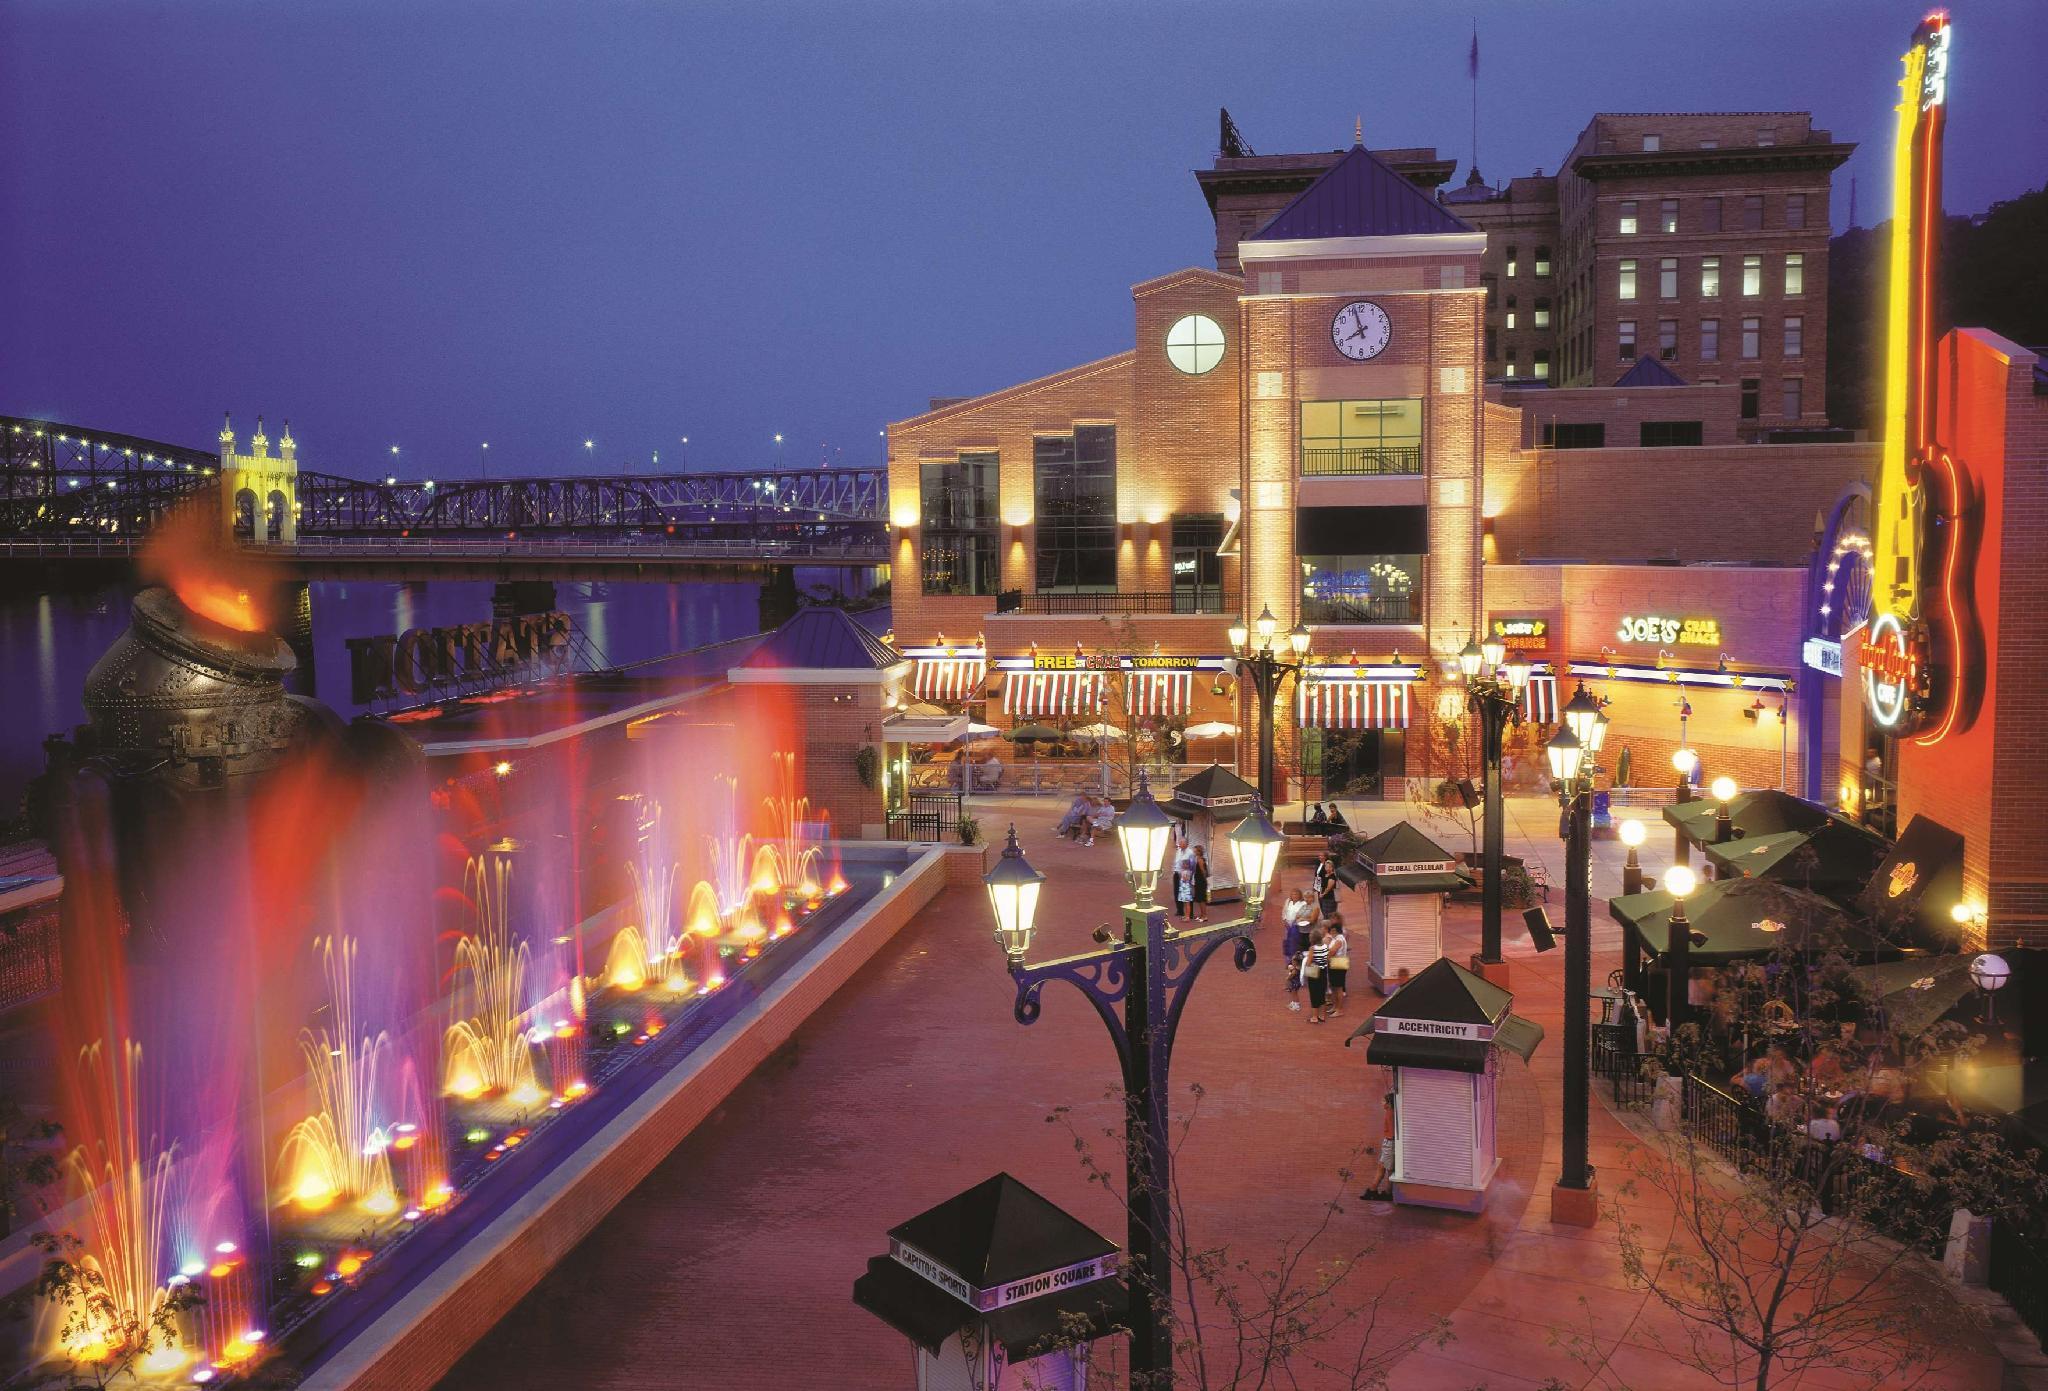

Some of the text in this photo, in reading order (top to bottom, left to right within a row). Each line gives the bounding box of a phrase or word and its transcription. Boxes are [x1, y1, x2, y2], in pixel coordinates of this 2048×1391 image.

[1617, 617, 1715, 643] JOE'S CRAB
[1680, 631, 1719, 645] SHACK
[1034, 656, 1199, 669] FREE CRAB TOMORROW
[1414, 864, 1444, 872] CELLULAR
[1398, 1021, 1468, 1036] ACCENTRICITY
[903, 1250, 967, 1298] CAPUTO'S SPORTS
[1005, 1263, 1096, 1300] STATION SQUARE
